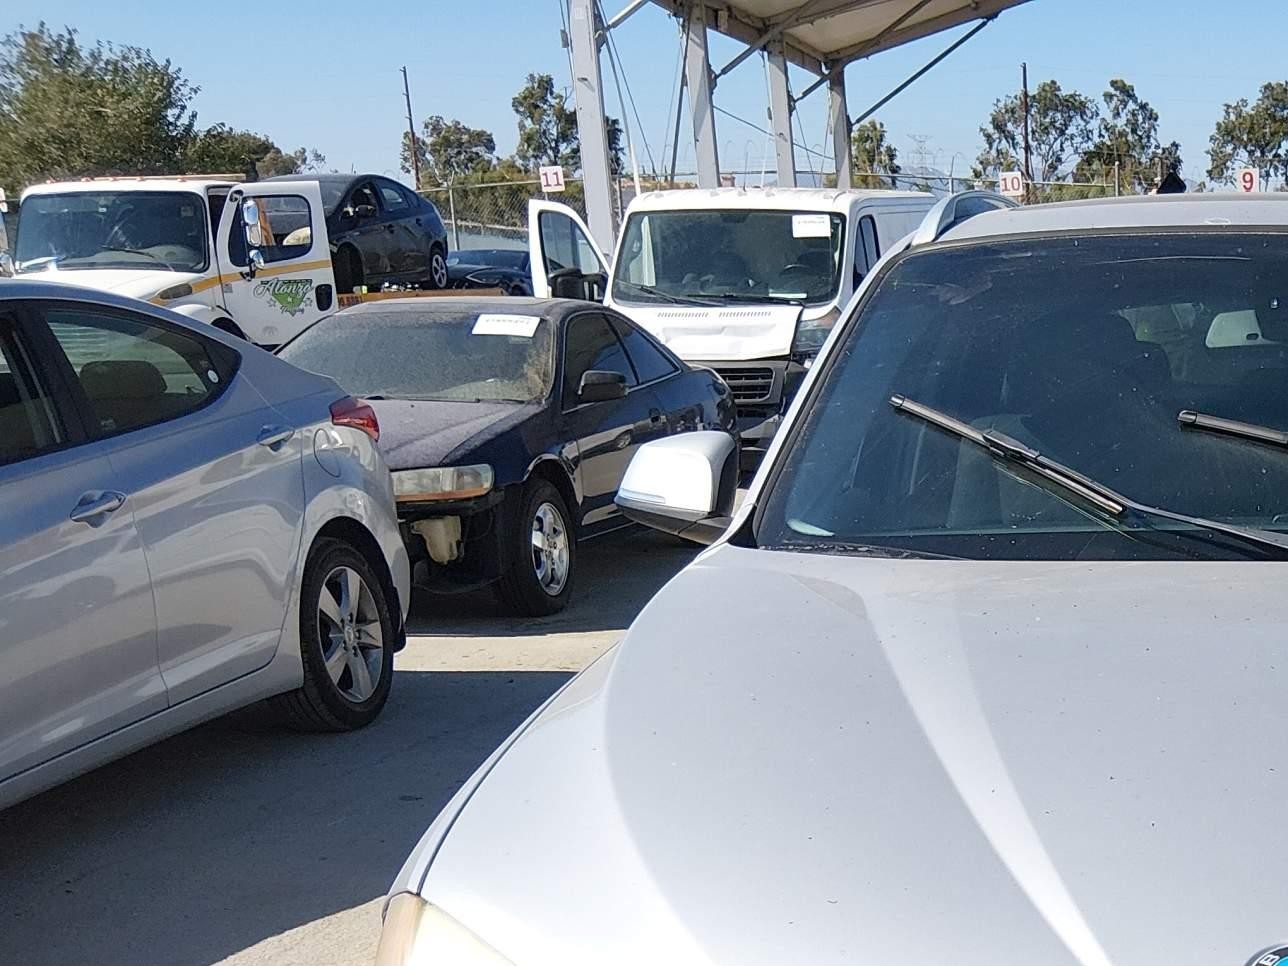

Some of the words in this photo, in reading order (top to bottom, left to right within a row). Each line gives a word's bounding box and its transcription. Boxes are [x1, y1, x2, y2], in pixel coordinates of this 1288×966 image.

[541, 171, 564, 188] 11
[1000, 175, 1022, 192] 10
[1242, 171, 1255, 191] 9
